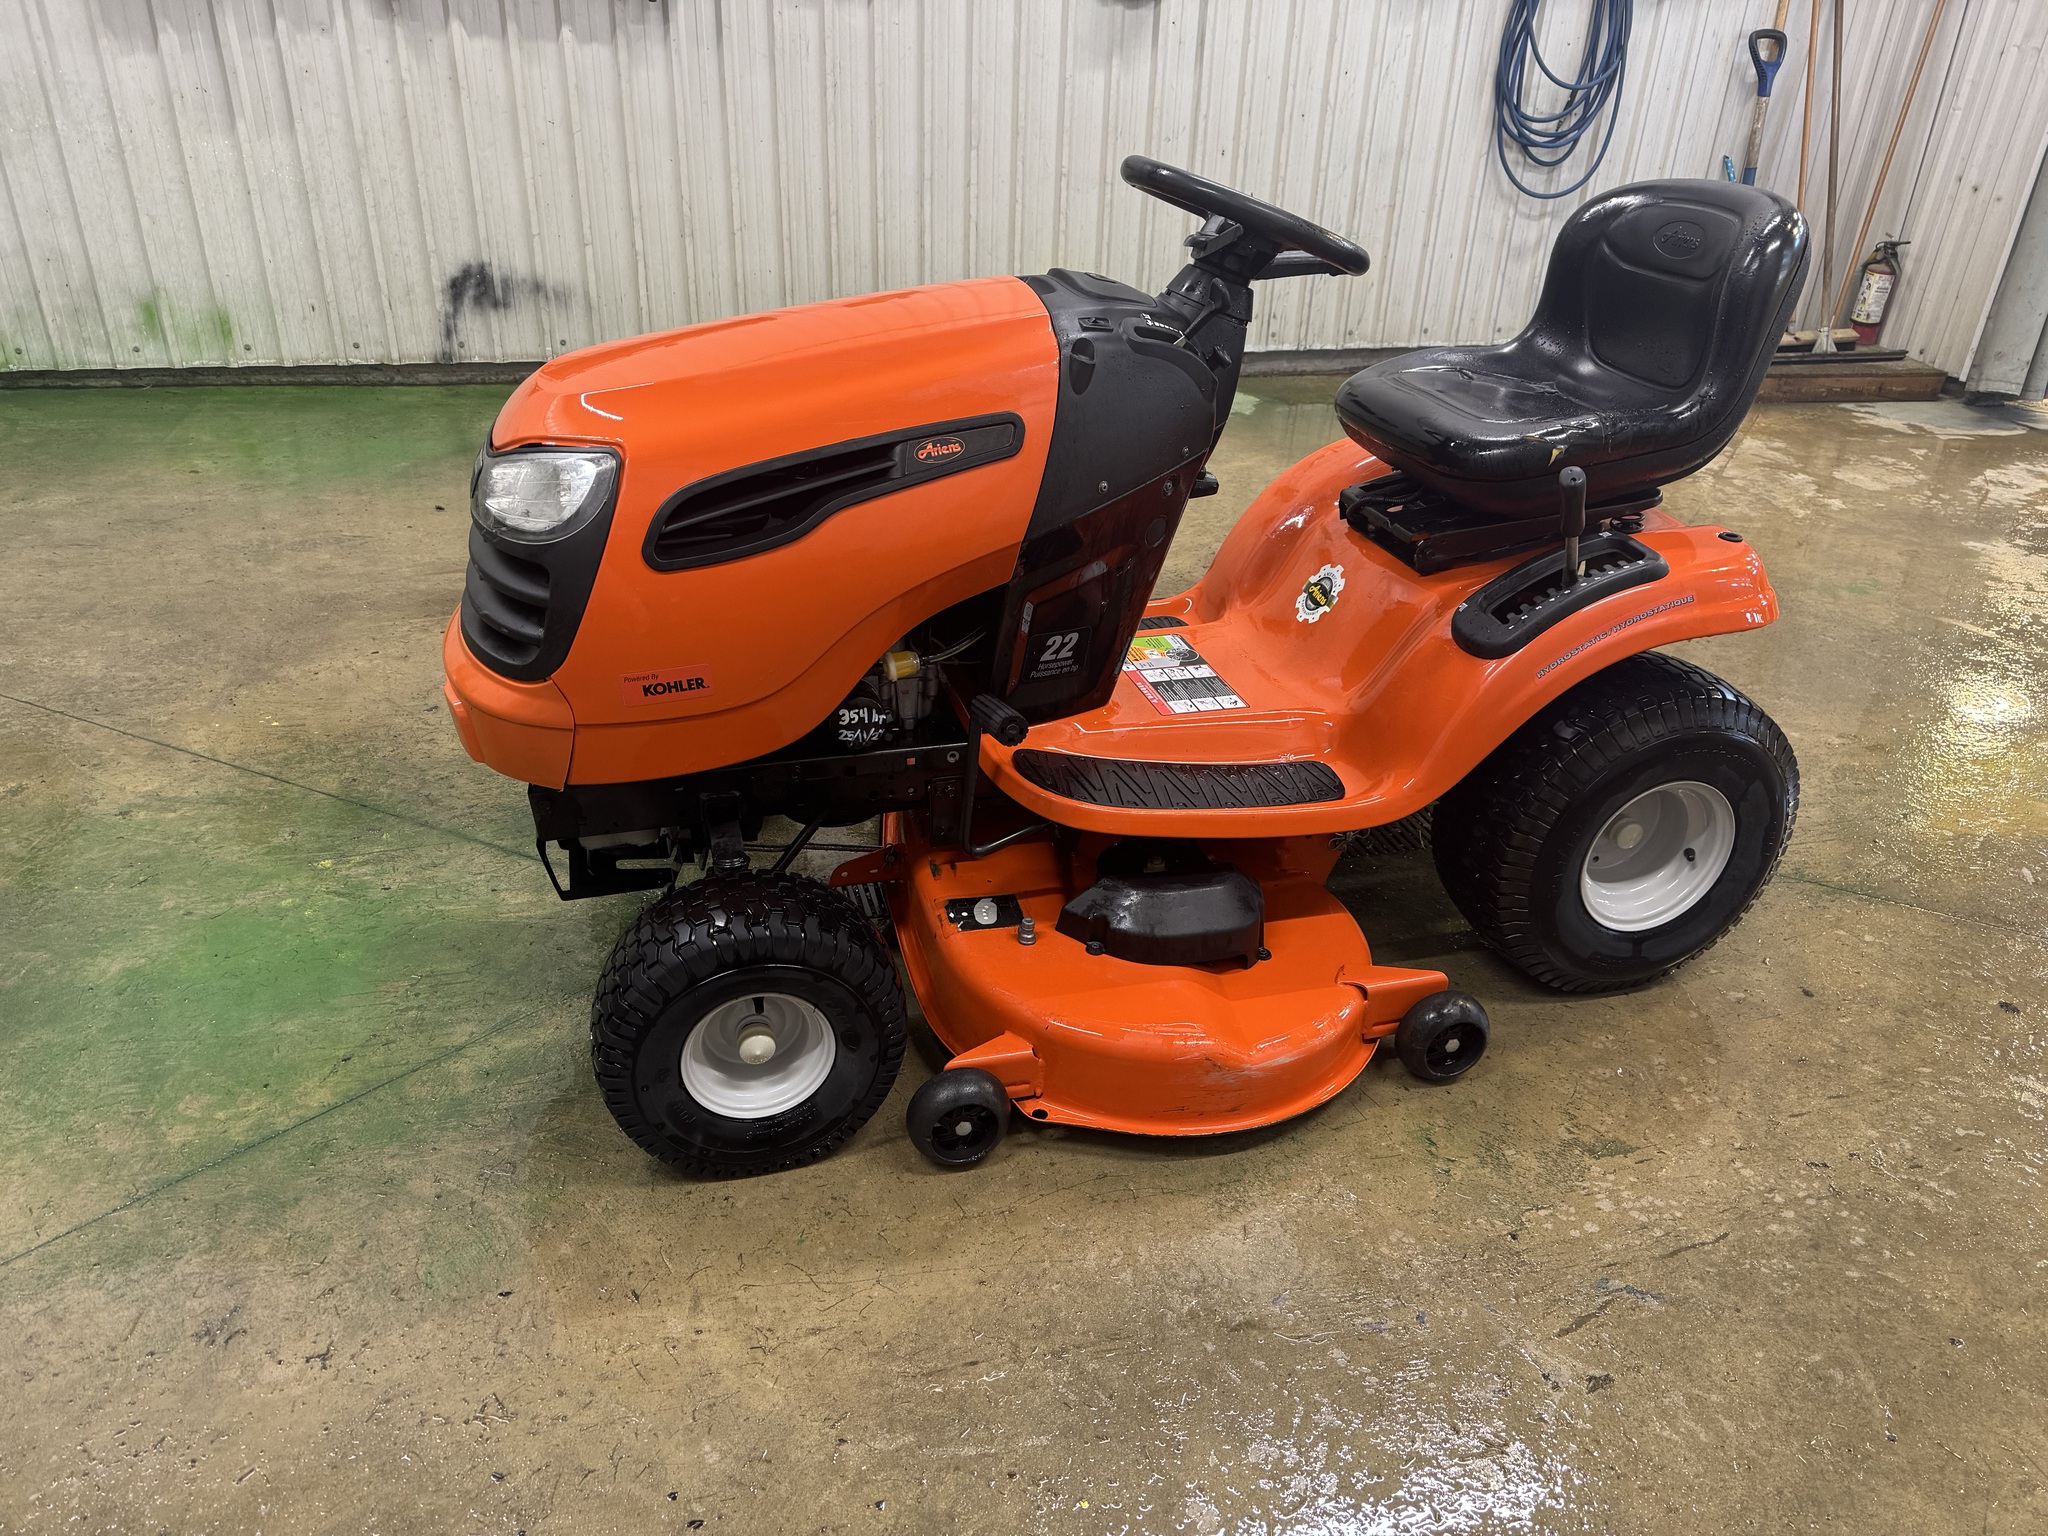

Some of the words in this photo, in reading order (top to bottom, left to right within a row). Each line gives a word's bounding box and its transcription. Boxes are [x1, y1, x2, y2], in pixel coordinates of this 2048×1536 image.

[917, 442, 962, 460] Ariens
[1309, 584, 1327, 606] Ariens
[1040, 632, 1079, 662] 22
[1029, 668, 1061, 679] Puissance
[1062, 666, 1070, 674] en
[1070, 664, 1079, 673] hp
[1037, 658, 1074, 672] Horsepower
[624, 674, 650, 683] Powered
[651, 673, 660, 681] By
[838, 707, 869, 725] 354
[872, 708, 887, 725] hr
